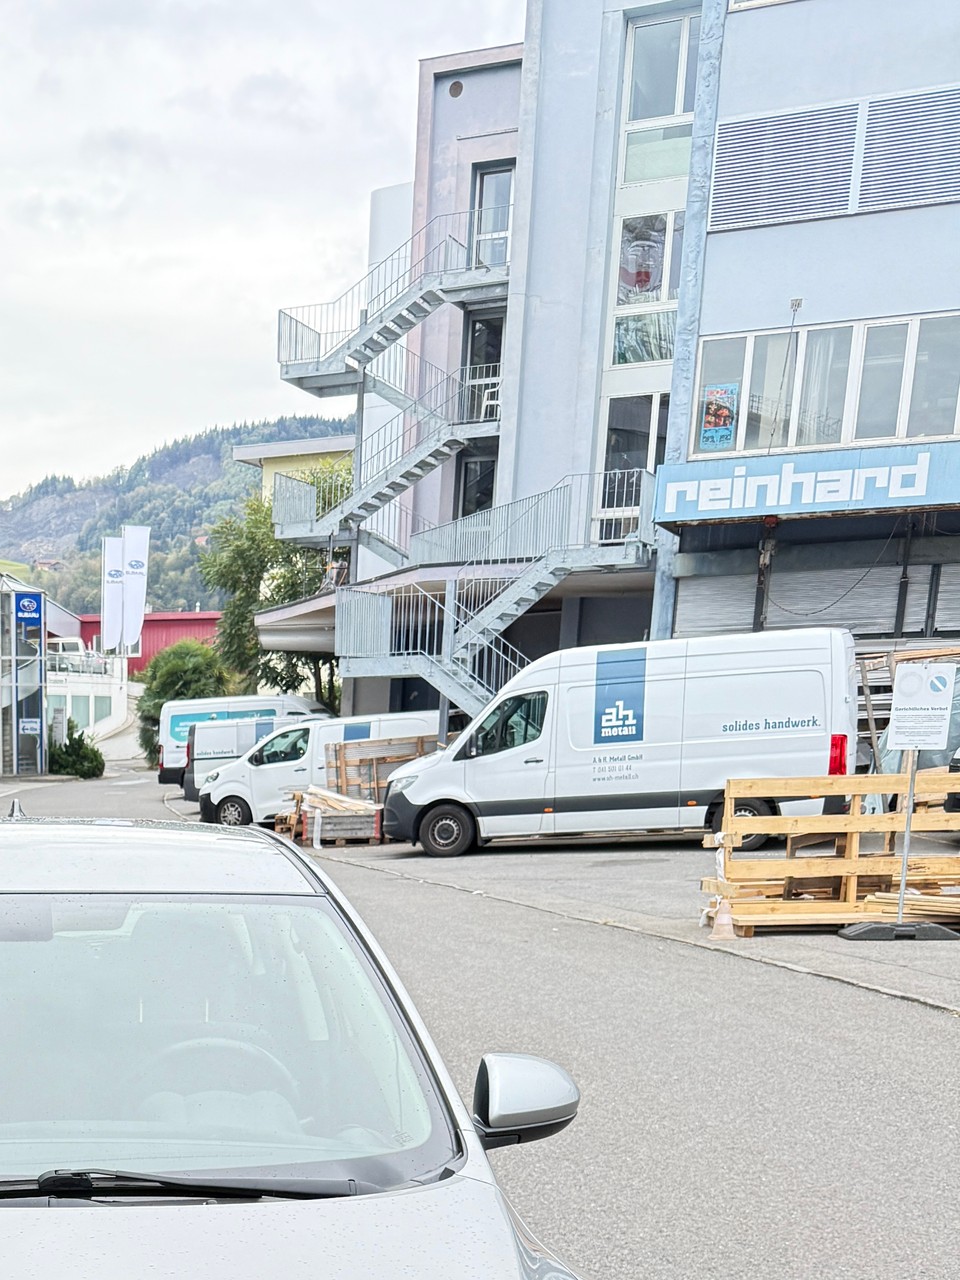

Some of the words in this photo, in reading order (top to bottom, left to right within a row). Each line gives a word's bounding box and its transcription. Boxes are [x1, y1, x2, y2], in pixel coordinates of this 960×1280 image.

[665, 452, 930, 513] reinhard
[601, 700, 637, 727] ah
[722, 720, 760, 732] solides
[764, 715, 821, 730] handwerk.
[601, 726, 637, 737] metall
